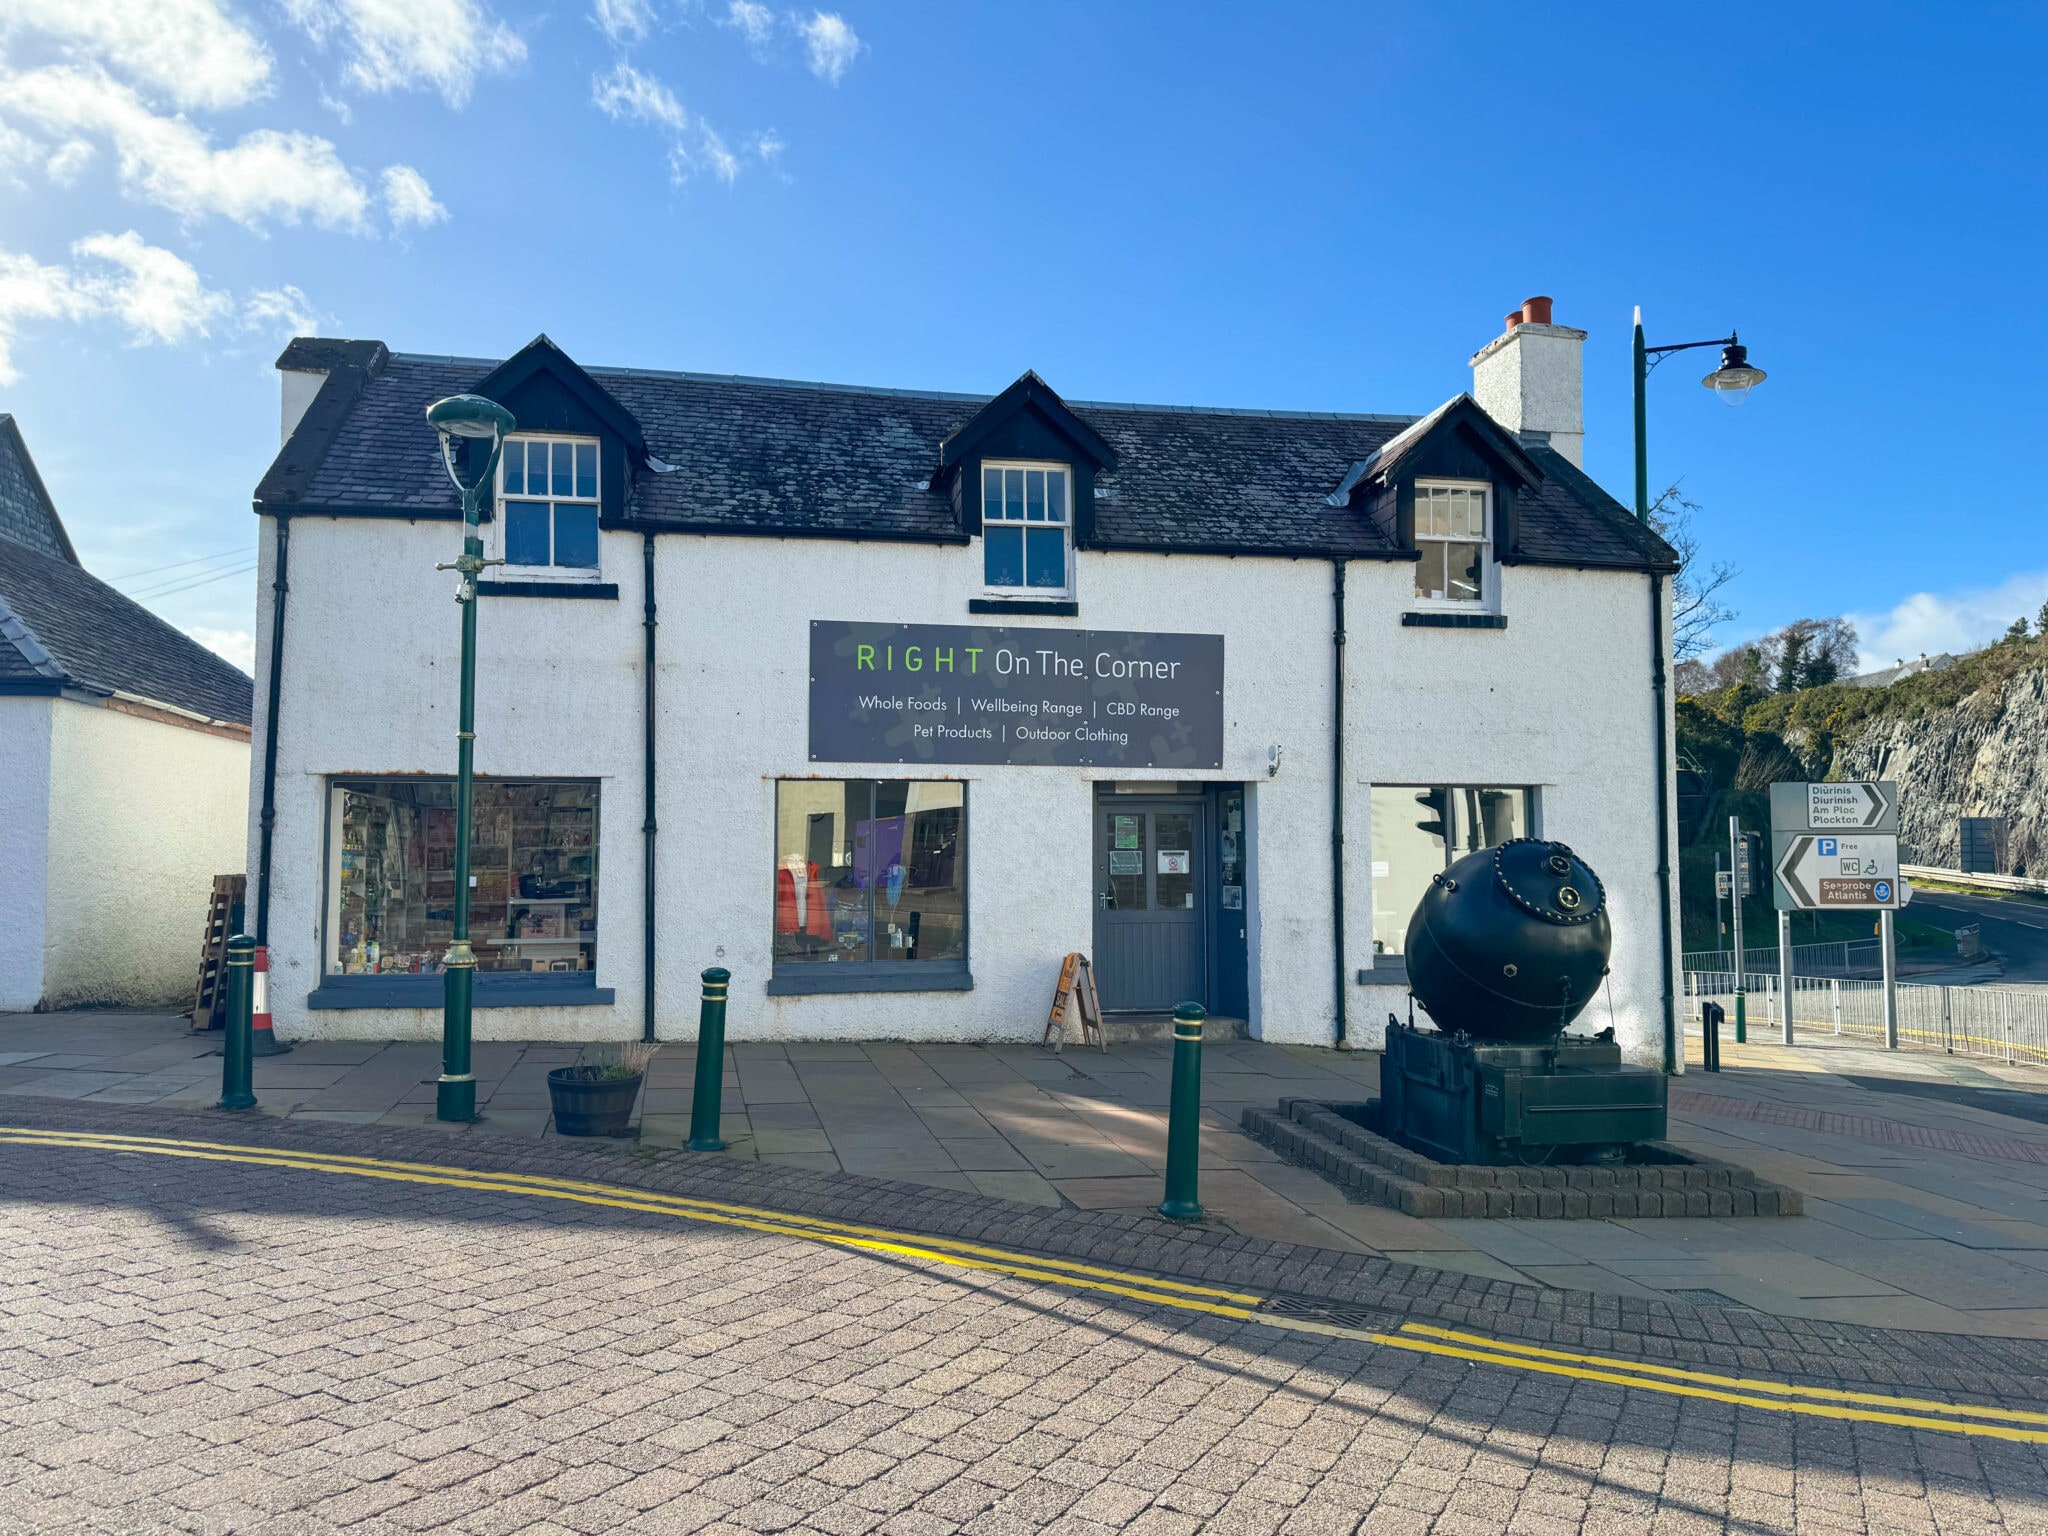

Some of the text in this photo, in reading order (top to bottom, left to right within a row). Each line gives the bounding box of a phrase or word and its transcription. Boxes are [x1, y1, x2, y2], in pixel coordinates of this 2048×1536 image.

[856, 645, 1181, 680] RIGHT On The Corner
[858, 695, 1180, 718] Whole Foods Wellbeing Range CBD Range
[913, 725, 1129, 745] Pet Products Outdoor Clothing
[1812, 796, 1858, 804] Diurinish
[1812, 806, 1856, 814] Am Ploc
[1813, 815, 1859, 824] Plockton
[1822, 840, 1835, 855] P
[1842, 862, 1858, 872] WC
[1827, 891, 1868, 900] Atlantis
